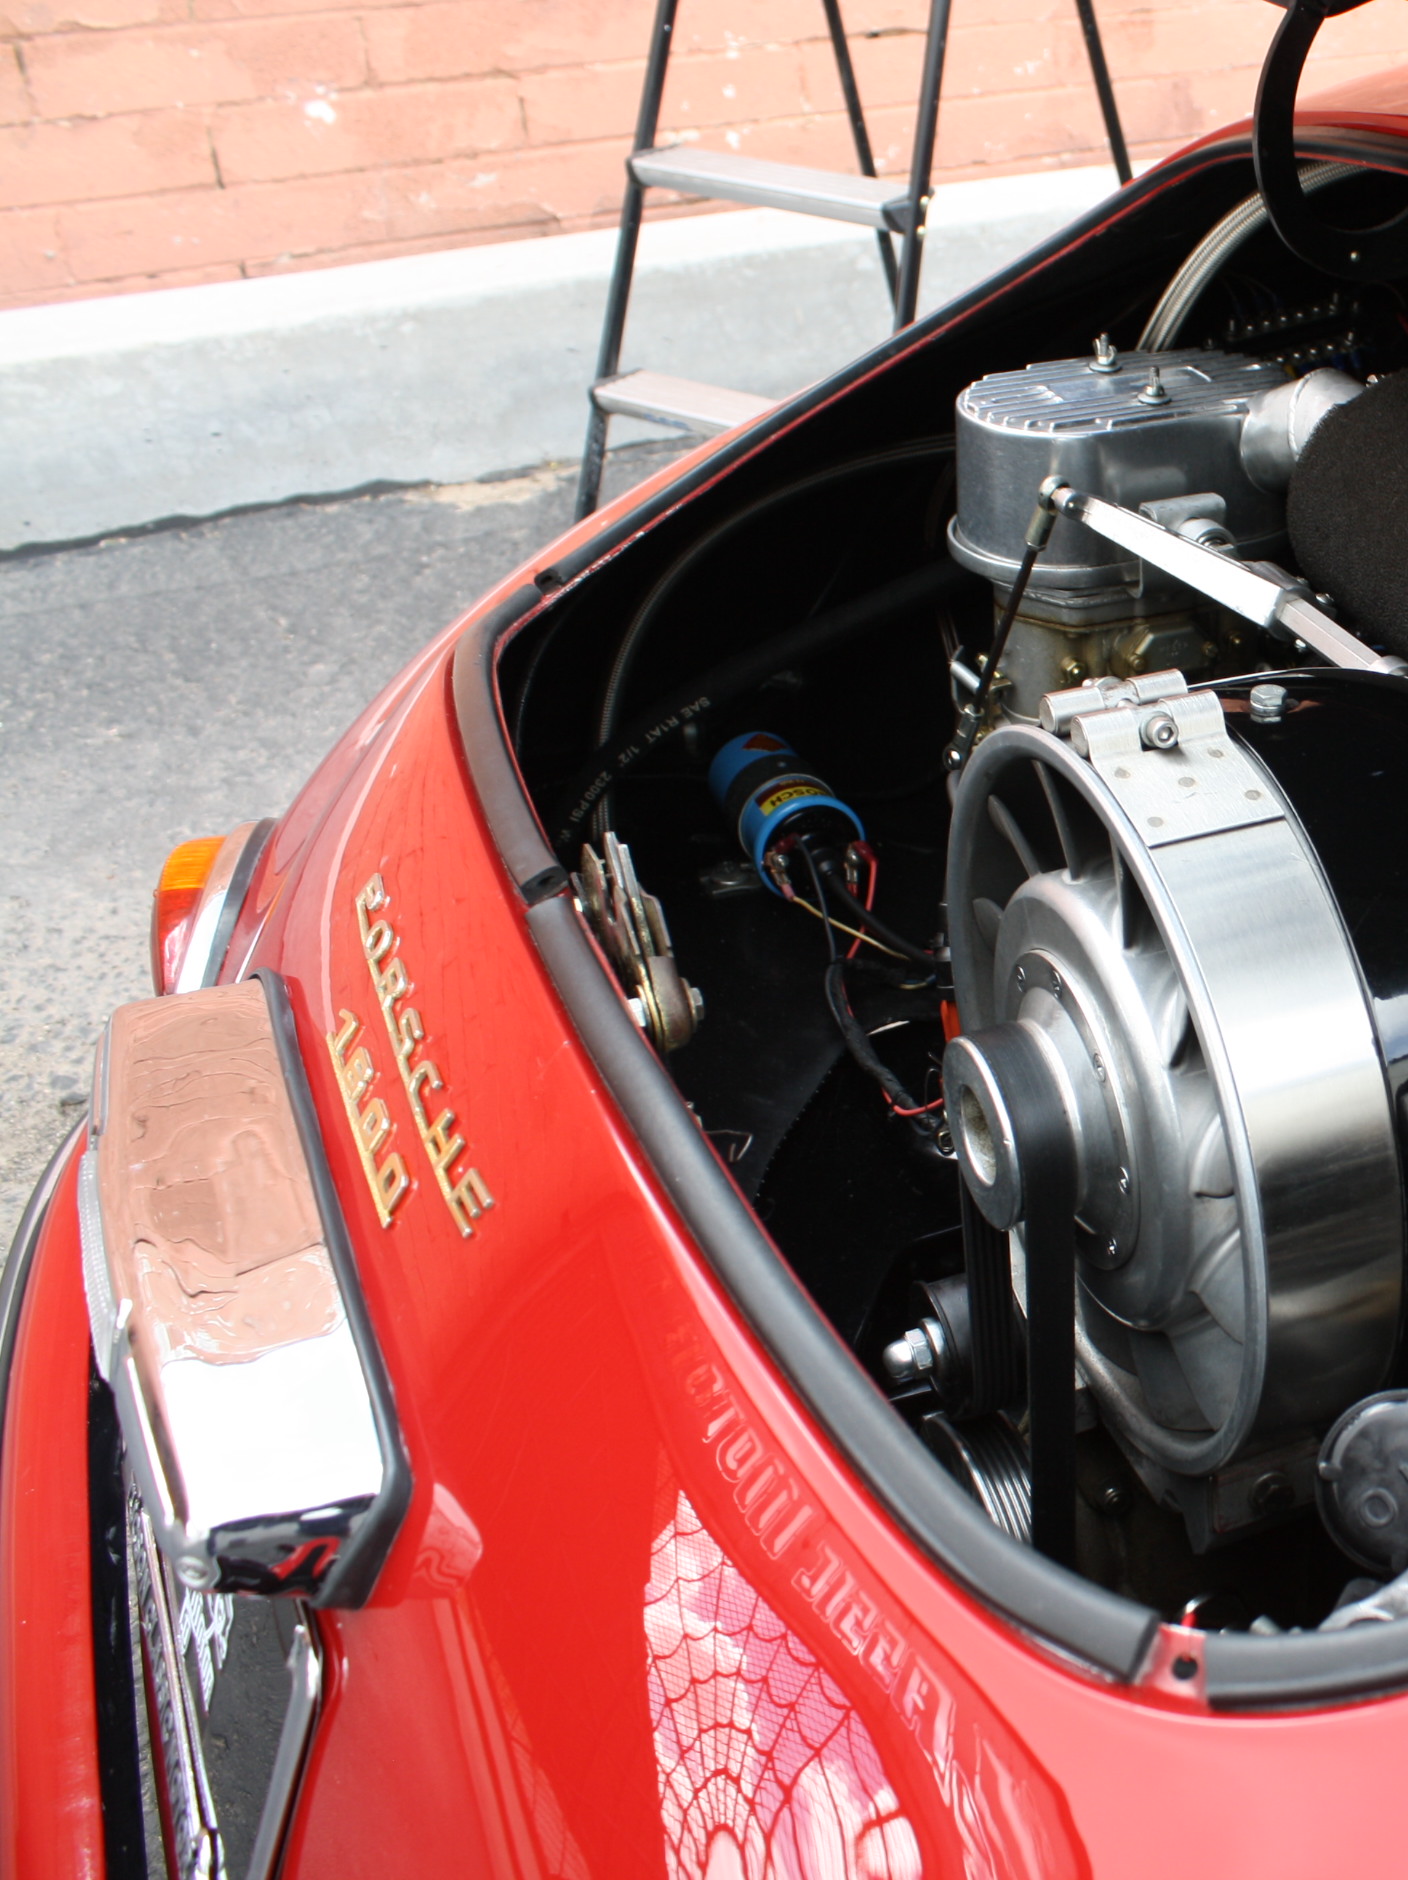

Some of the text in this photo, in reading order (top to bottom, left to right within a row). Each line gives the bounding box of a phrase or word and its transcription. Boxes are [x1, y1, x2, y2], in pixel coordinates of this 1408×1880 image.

[680, 696, 711, 719] SAE
[584, 770, 612, 801] 2300
[355, 872, 494, 1239] PORSCHE
